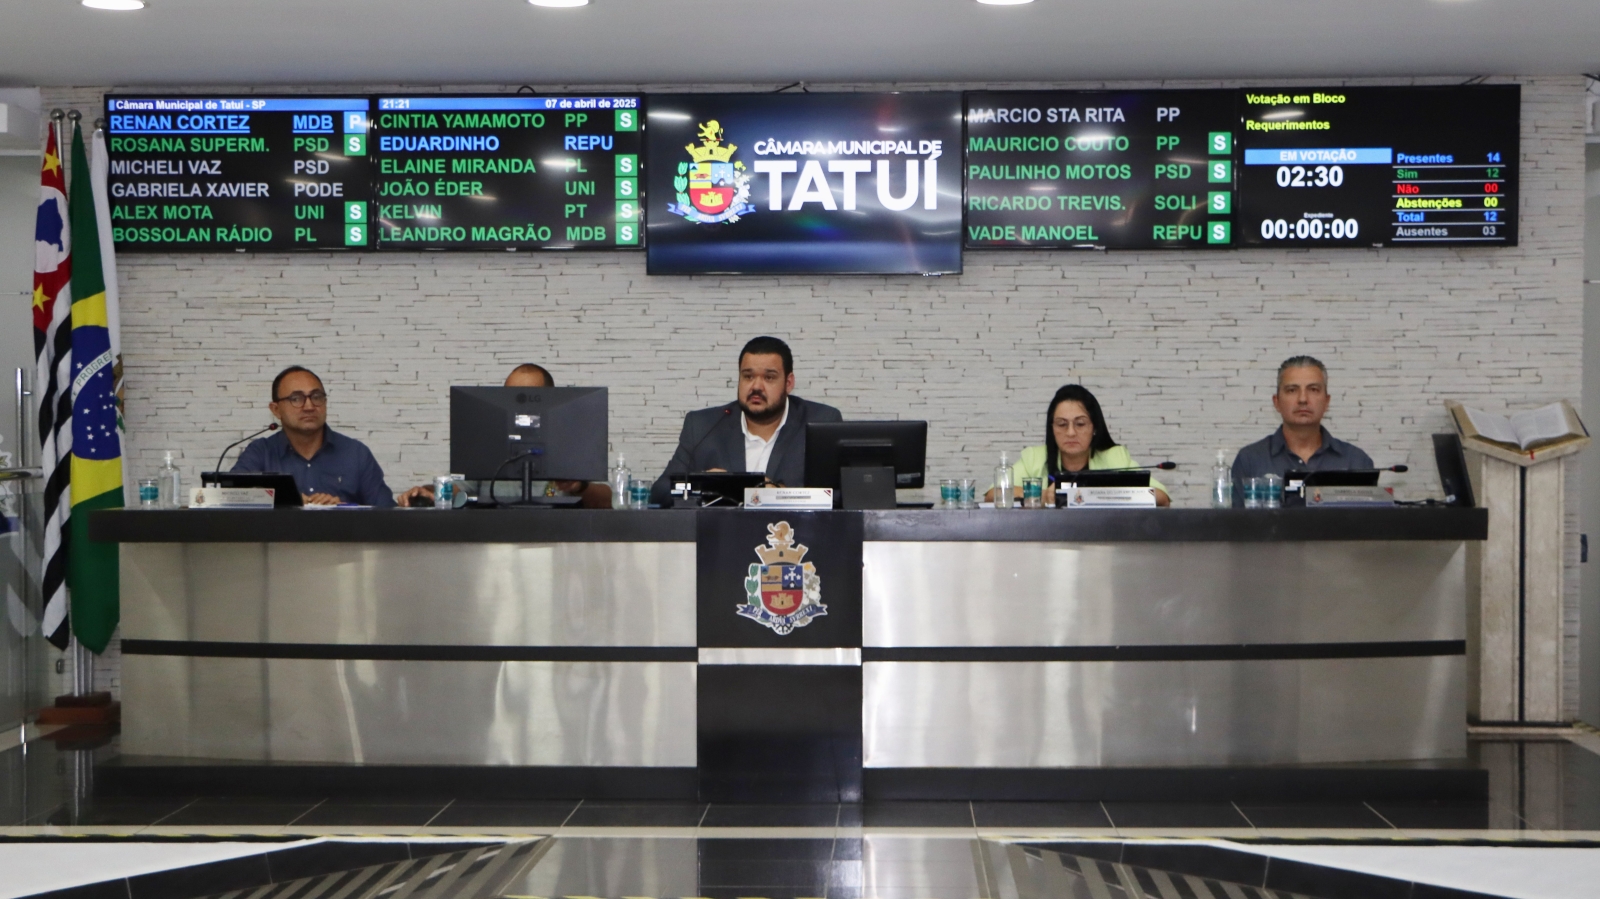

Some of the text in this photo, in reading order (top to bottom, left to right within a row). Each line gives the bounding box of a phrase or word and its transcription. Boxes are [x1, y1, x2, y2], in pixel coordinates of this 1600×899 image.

[116, 100, 153, 109] Câmara
[156, 100, 203, 111] Municipal
[205, 100, 218, 109] de
[220, 100, 244, 109] Tatuí
[252, 100, 266, 110] SP
[383, 99, 636, 108] 21:21 07 de abril de 2025
[1246, 94, 1291, 106] Votação
[1313, 93, 1345, 103] Bloco
[111, 115, 362, 130] RENAN CORTEZ MDB P
[381, 112, 632, 128] CINTIA YAMAMOTO PP S
[969, 108, 1180, 122] MARCIO STA RITA PP
[1246, 119, 1330, 132] Requerimentos
[112, 137, 360, 153] ROSANA SUPERM. PSD S
[380, 136, 613, 151] EDUARDINHO REPU
[754, 138, 942, 155] CÂMARA MUNICIPAL DE
[970, 135, 1226, 151] MAURICIO COUTO PP S
[1280, 149, 1357, 163] EM VOTAÇÃO
[1397, 153, 1500, 163] Presentes 14
[112, 159, 332, 174] MICHELI VAZ PSD
[382, 158, 632, 173] ELAINE MIRANDA PL S
[969, 163, 1225, 180] PAULINHO MOTOS PSD S
[1397, 167, 1499, 178] Sim 12
[754, 154, 942, 211] TATUÍ
[1276, 166, 1344, 187] 02:30
[112, 183, 343, 197] GABRIELA XAVIER PODE
[380, 179, 632, 196] JOÃO ÉDER UNI S
[1397, 183, 1498, 193] Não 00
[969, 194, 1225, 210] RICARDO TREVIS. SOLI S
[1396, 197, 1498, 209] Abstenções 00
[113, 204, 361, 219] ALEX MOTA UNI S
[380, 204, 632, 219] KELVIN PT S
[1396, 211, 1497, 222] Total 12
[114, 224, 362, 242] BOSSOLAN RÁDIO PL S
[380, 224, 632, 241] LEANDRO MAGRÃO MDB S
[969, 224, 1225, 240] VADE MANOEL REPU S
[1261, 218, 1358, 239] 00:00:00
[1396, 226, 1496, 236] Ausentes 03
[528, 394, 542, 403] LG
